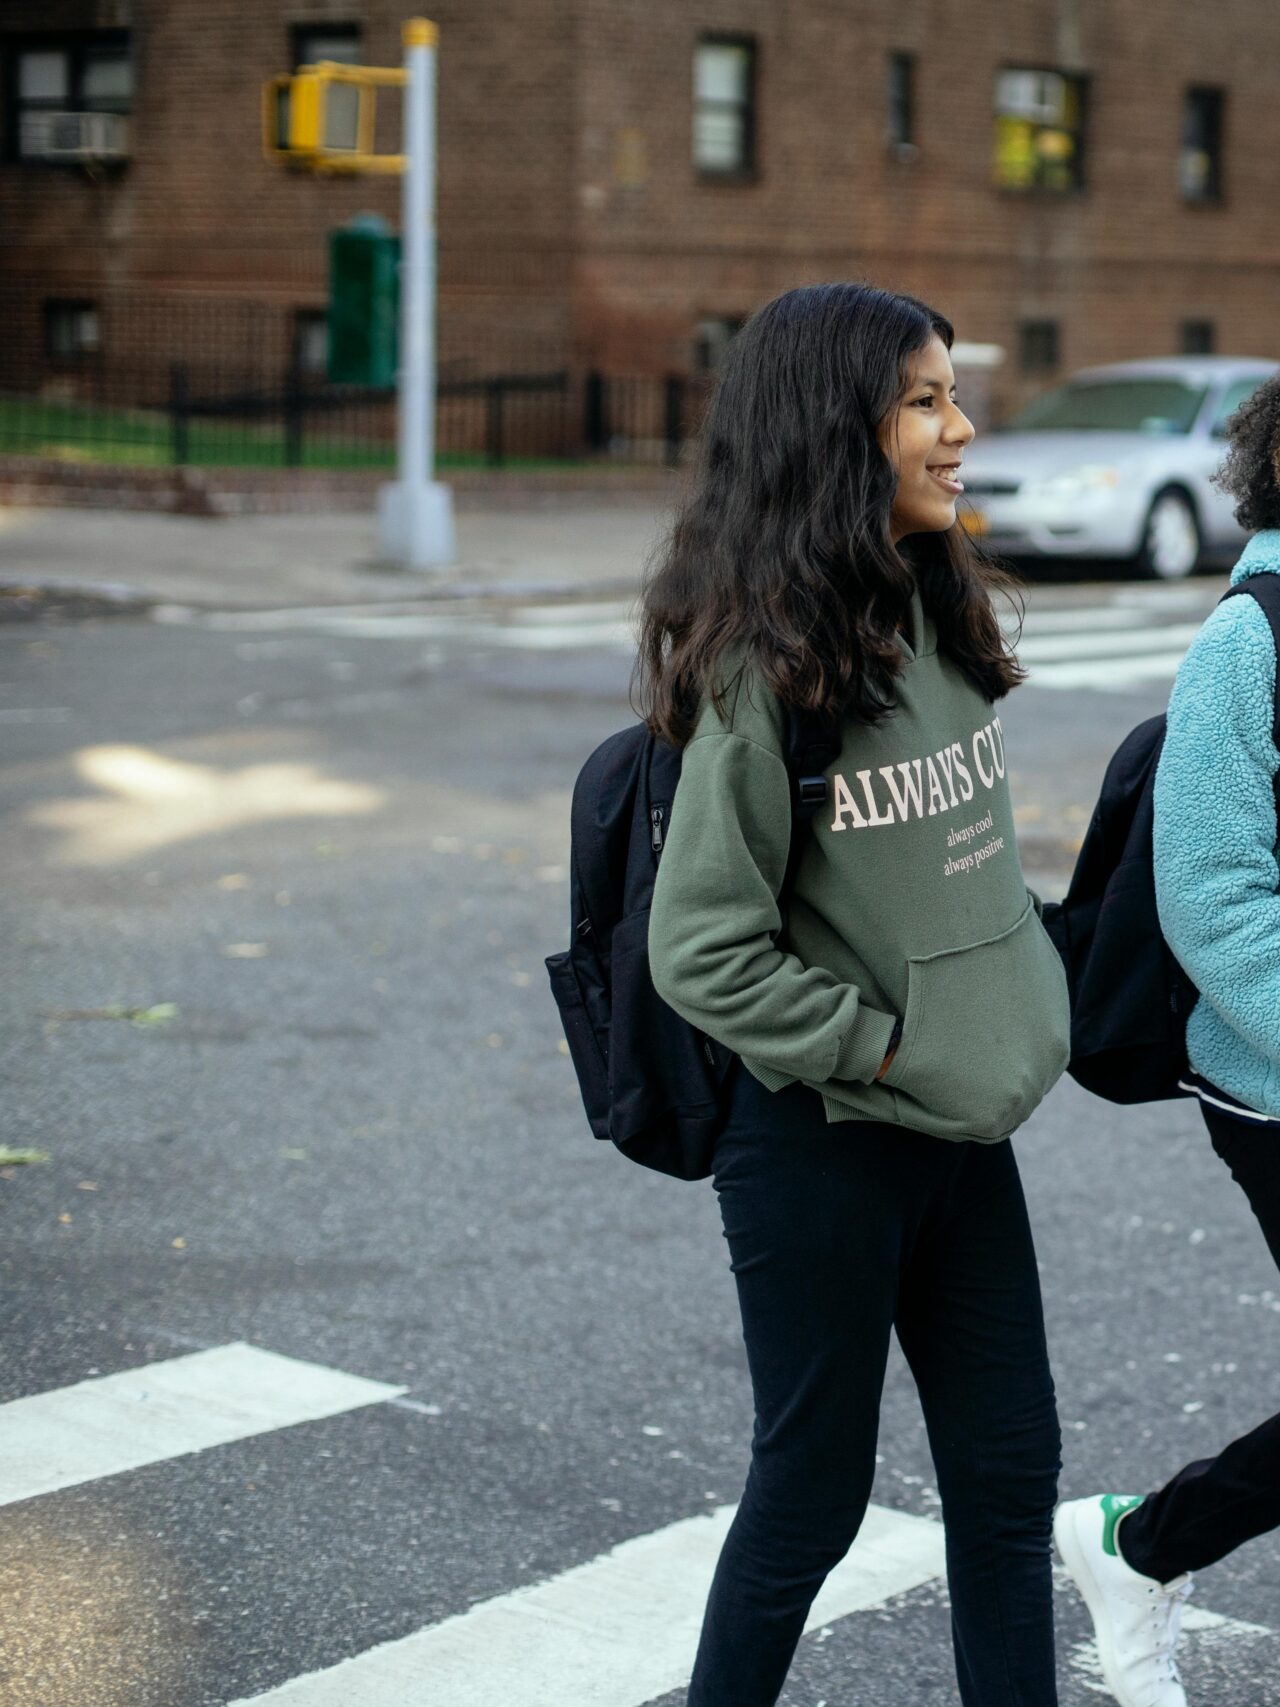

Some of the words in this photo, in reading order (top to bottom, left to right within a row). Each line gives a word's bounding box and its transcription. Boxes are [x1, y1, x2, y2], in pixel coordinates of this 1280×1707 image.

[831, 742, 973, 831] ALWAYS
[947, 826, 975, 847] always
[975, 810, 994, 834] cool
[944, 855, 974, 876] always
[974, 836, 1004, 868] positive
